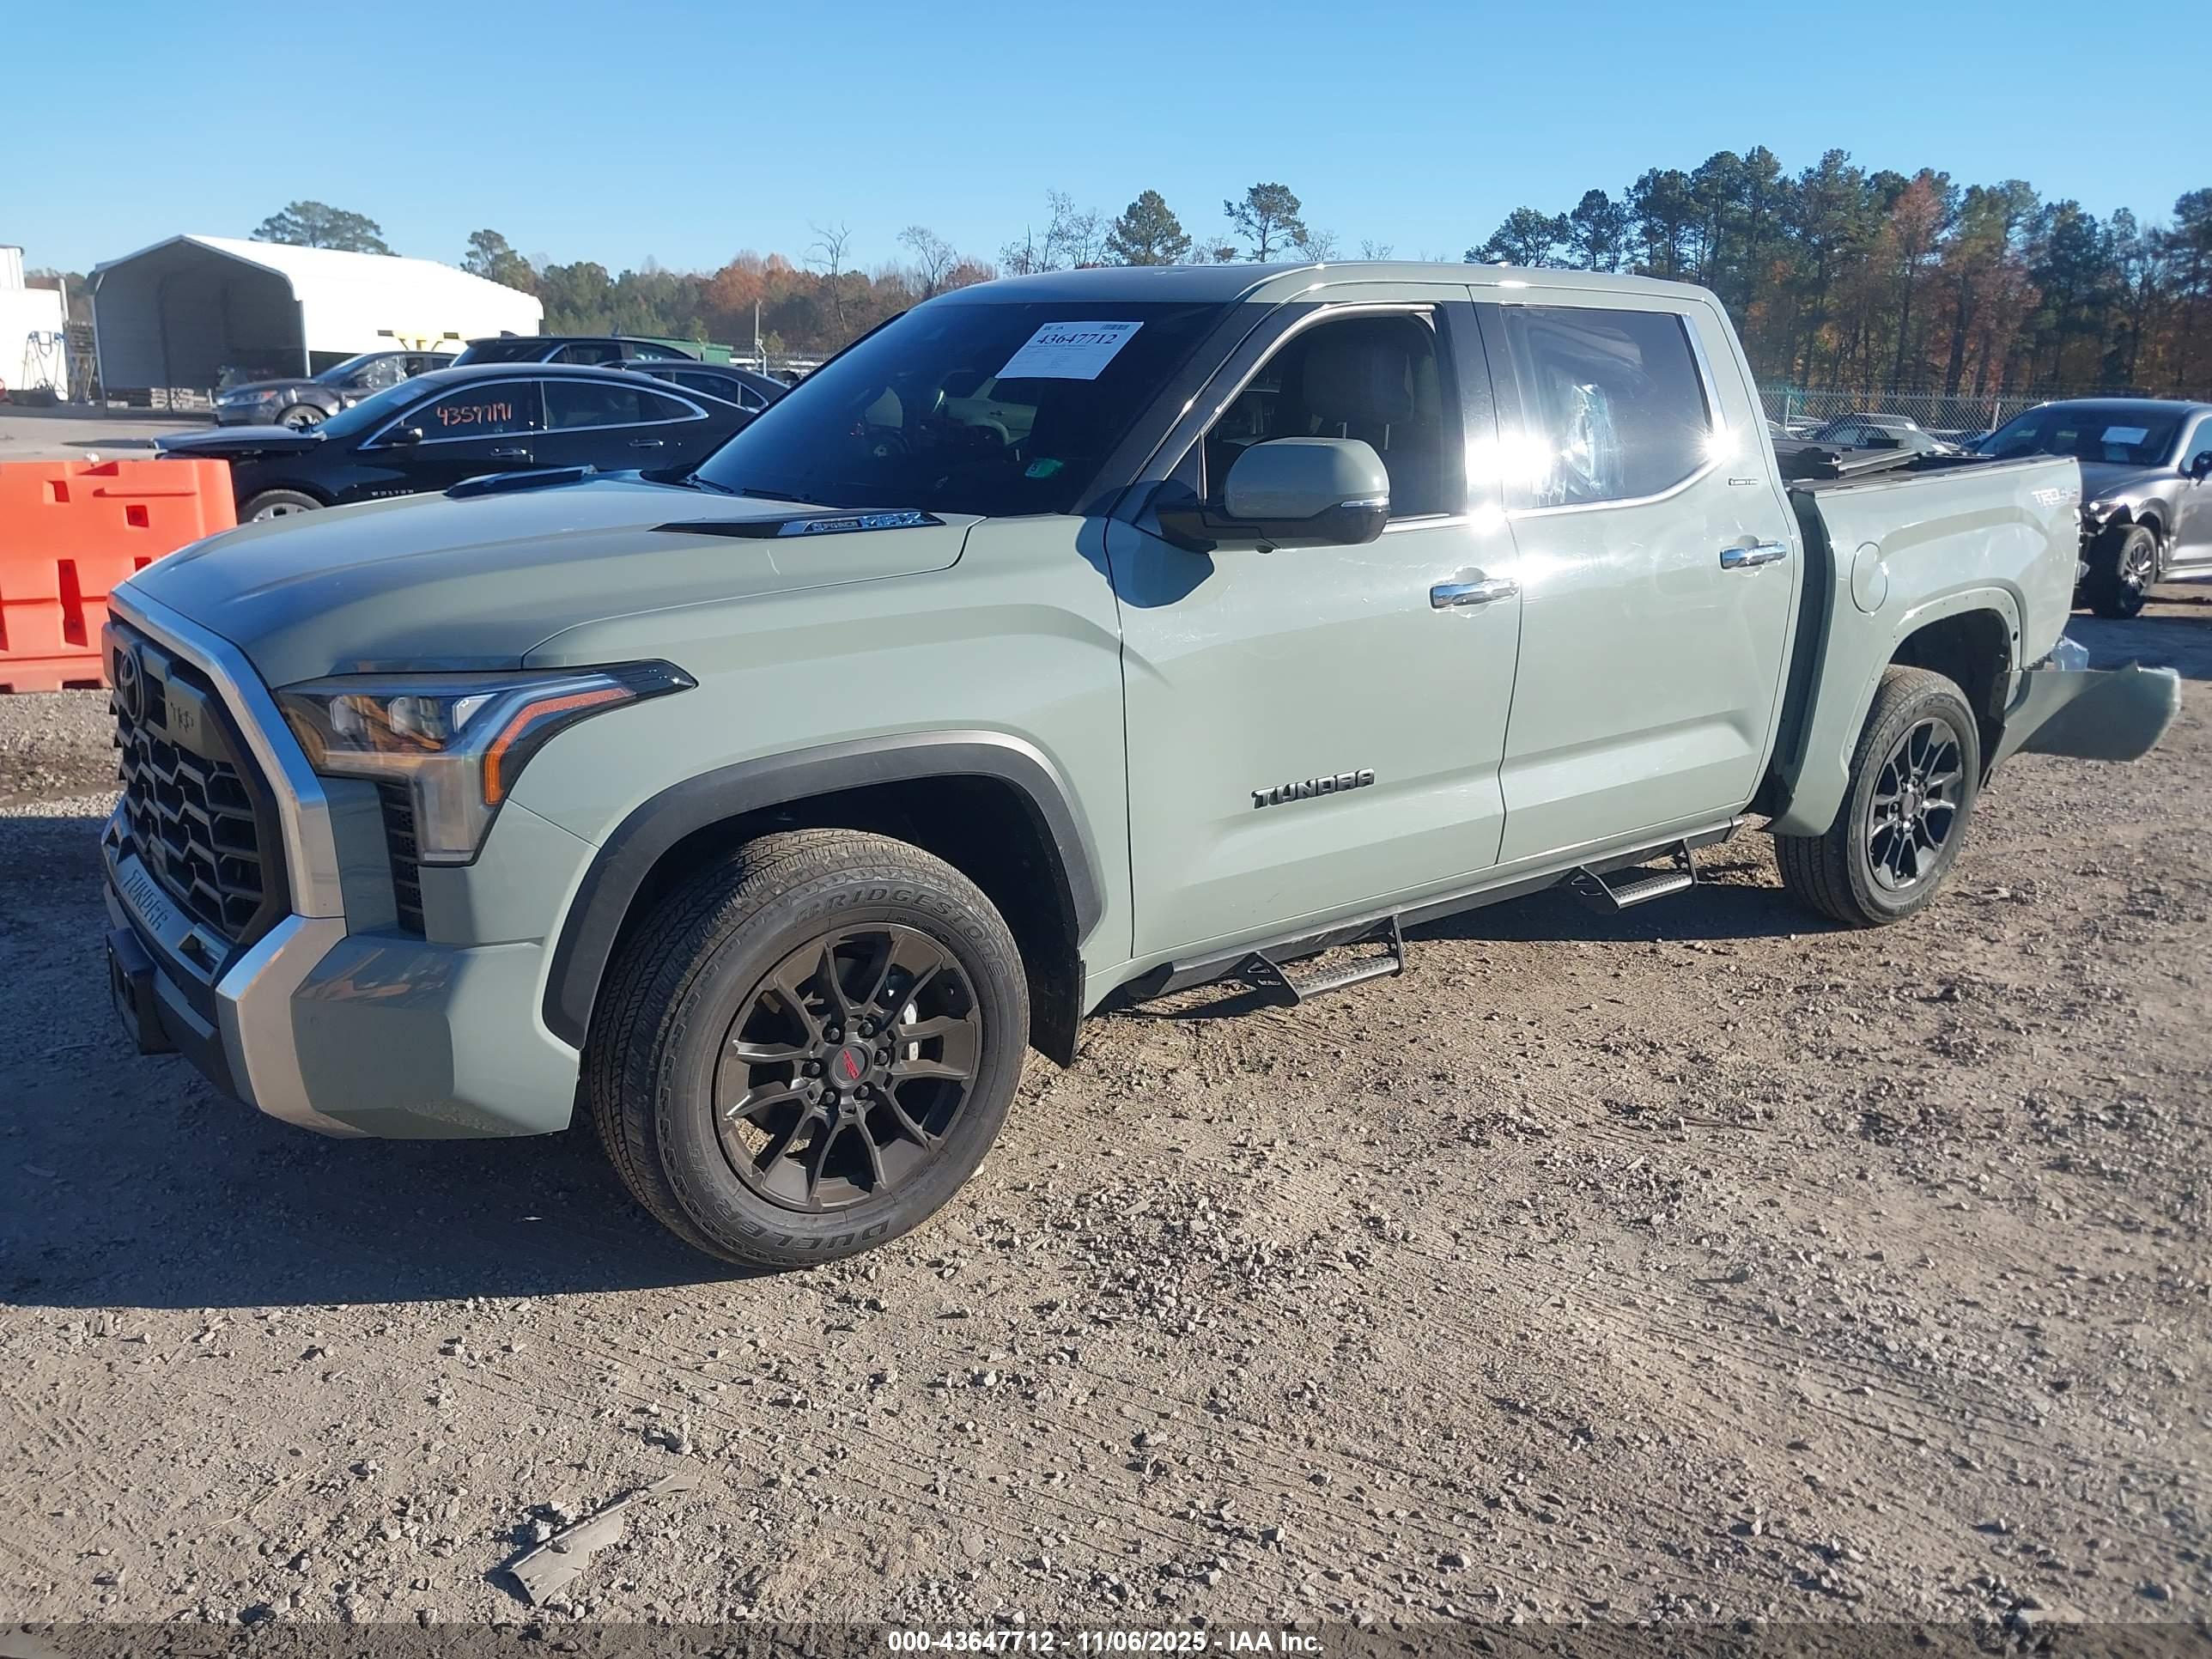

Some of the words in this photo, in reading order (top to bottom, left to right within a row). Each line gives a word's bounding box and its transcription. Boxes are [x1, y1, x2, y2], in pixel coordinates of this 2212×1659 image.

[1036, 332, 1119, 344] 43647712
[1251, 768, 1375, 809] TUNDRA
[123, 868, 170, 931] TUNDRA
[794, 886, 1008, 978] BRIDGESTONE
[712, 1198, 890, 1250] DUELER
